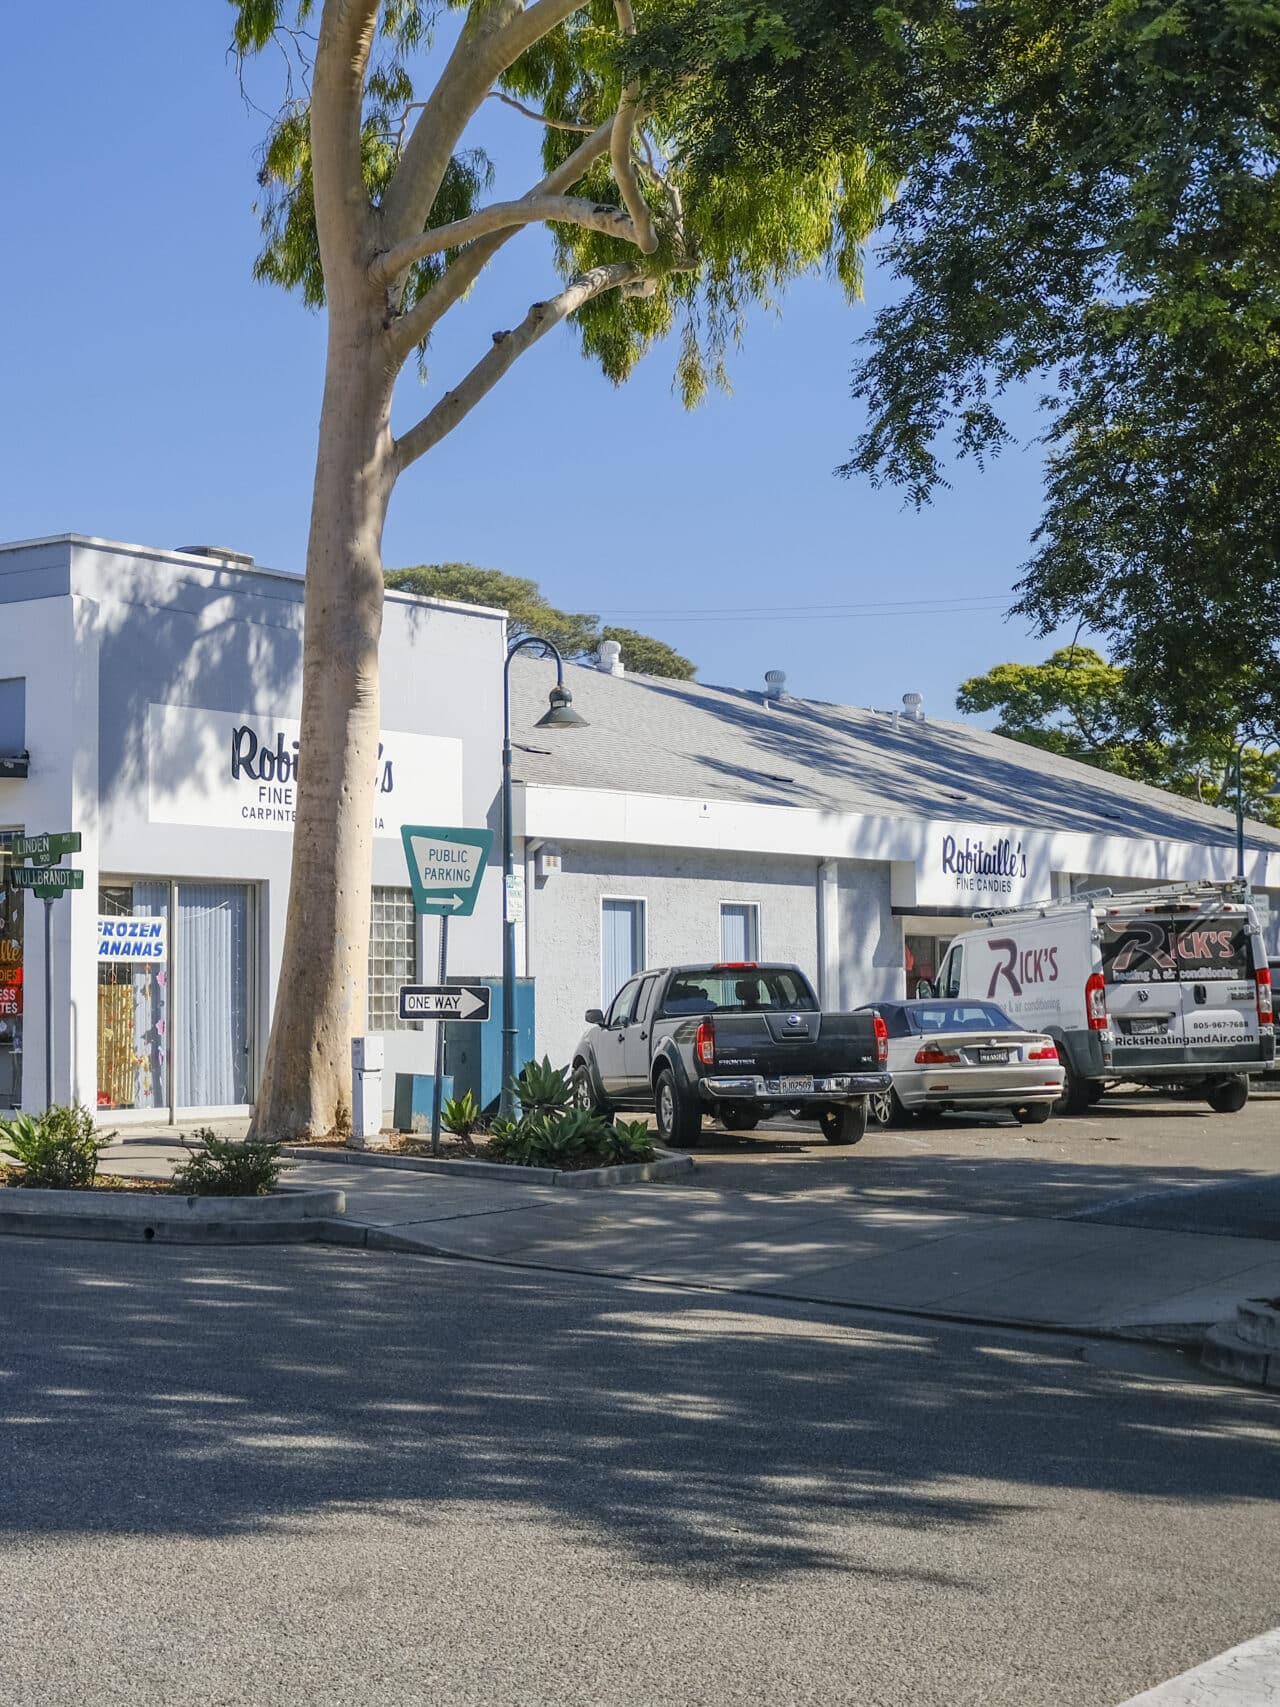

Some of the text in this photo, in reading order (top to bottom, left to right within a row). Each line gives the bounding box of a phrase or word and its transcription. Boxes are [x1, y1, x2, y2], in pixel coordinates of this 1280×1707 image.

[258, 786, 293, 805] FINE
[17, 836, 49, 855] LINDEN
[429, 849, 468, 863] PUBLIC
[942, 835, 1027, 878] Robitaille's
[14, 870, 70, 886] WULLBRANDT
[424, 867, 470, 882] PARKING
[956, 878, 1012, 892] FINE CANDIES
[98, 940, 163, 957] ANANAS
[1112, 969, 1150, 982] heating
[1152, 969, 1161, 980] &
[1180, 967, 1239, 979] conditioning
[408, 996, 461, 1009] ONE WAY
[1115, 1034, 1255, 1047] RicksHeatingandAir.com
